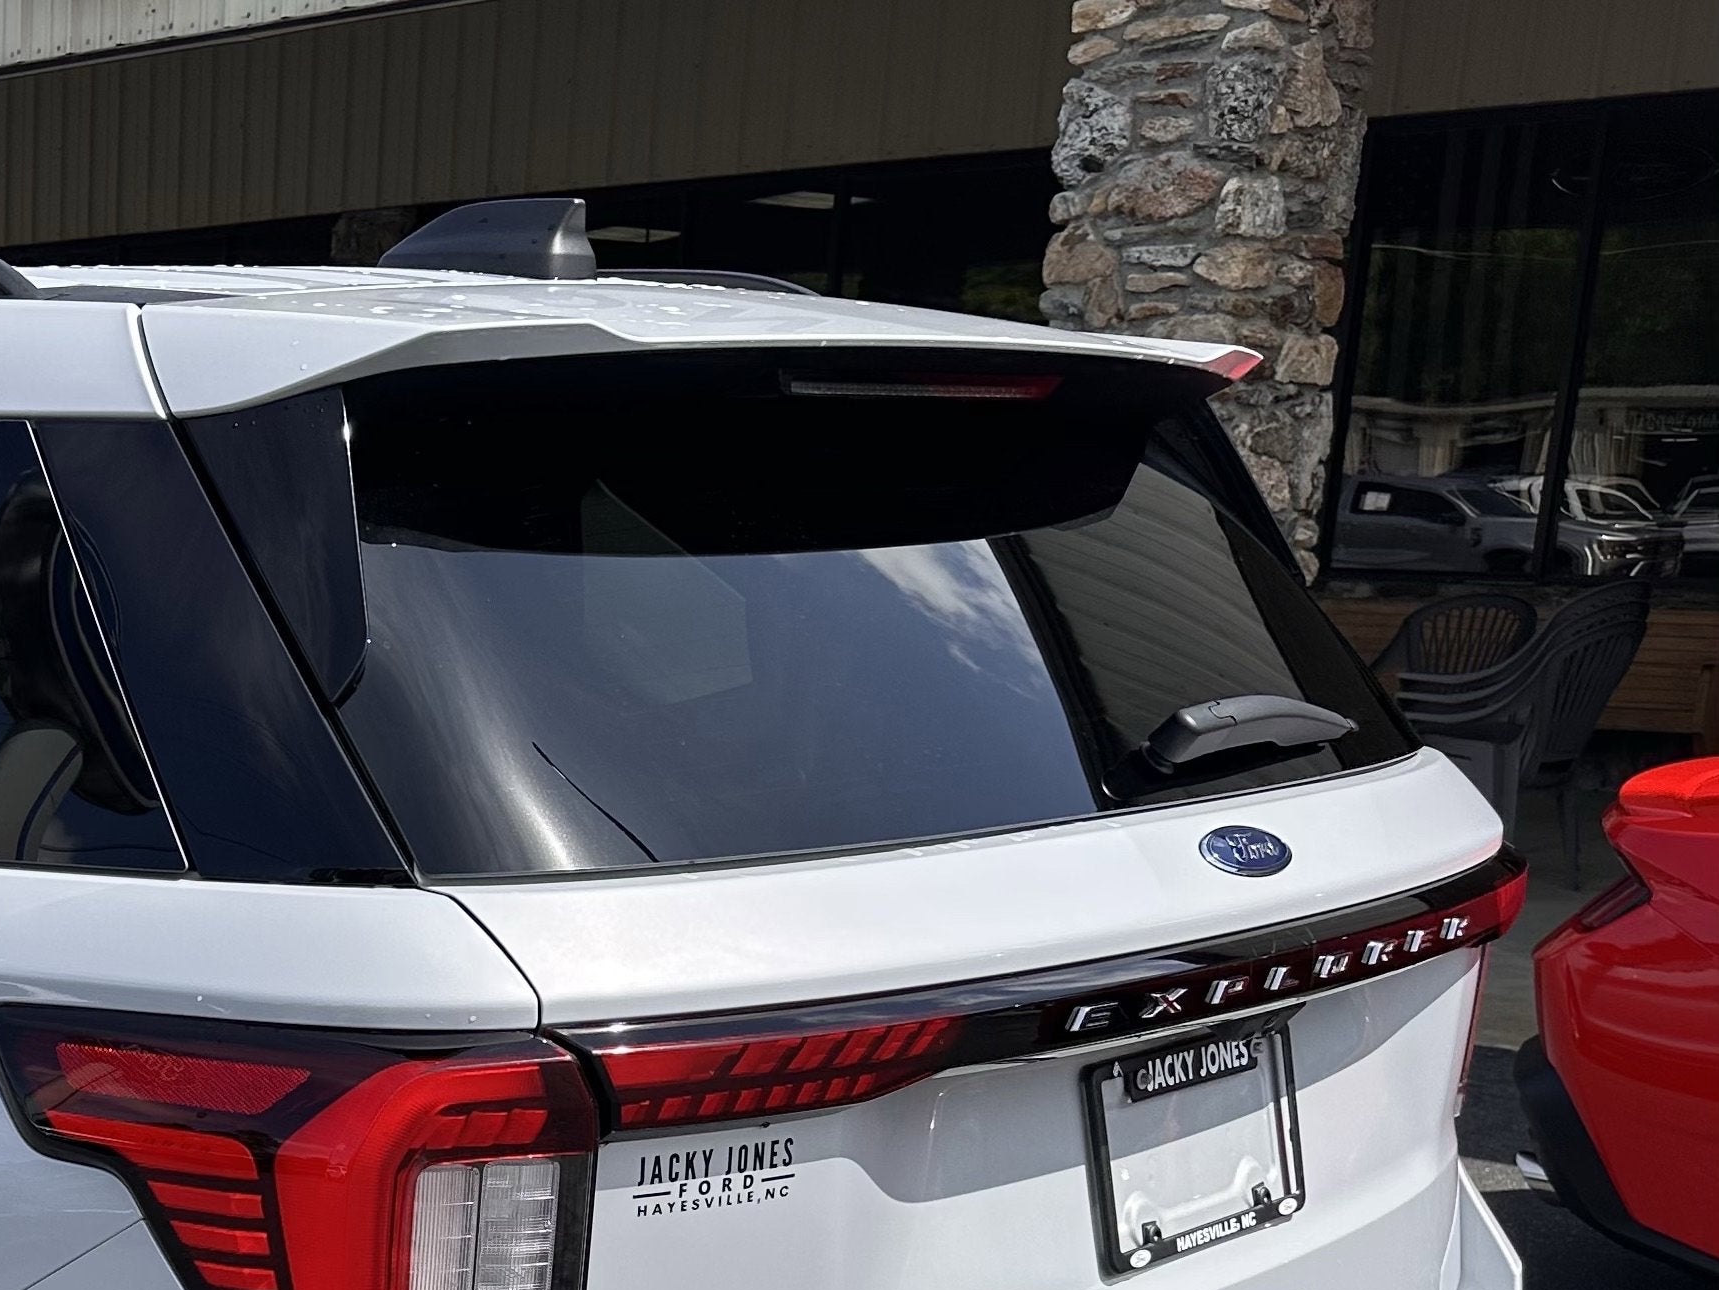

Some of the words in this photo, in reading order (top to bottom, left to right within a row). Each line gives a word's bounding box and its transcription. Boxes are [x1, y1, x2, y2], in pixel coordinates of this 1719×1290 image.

[1064, 916, 1472, 1033] EXPLORER
[1147, 1049, 1195, 1092] JACKY
[1199, 1040, 1249, 1077] JONES
[637, 1148, 714, 1187] JACKY
[725, 1137, 795, 1178] JONES
[678, 1174, 755, 1199] FORD
